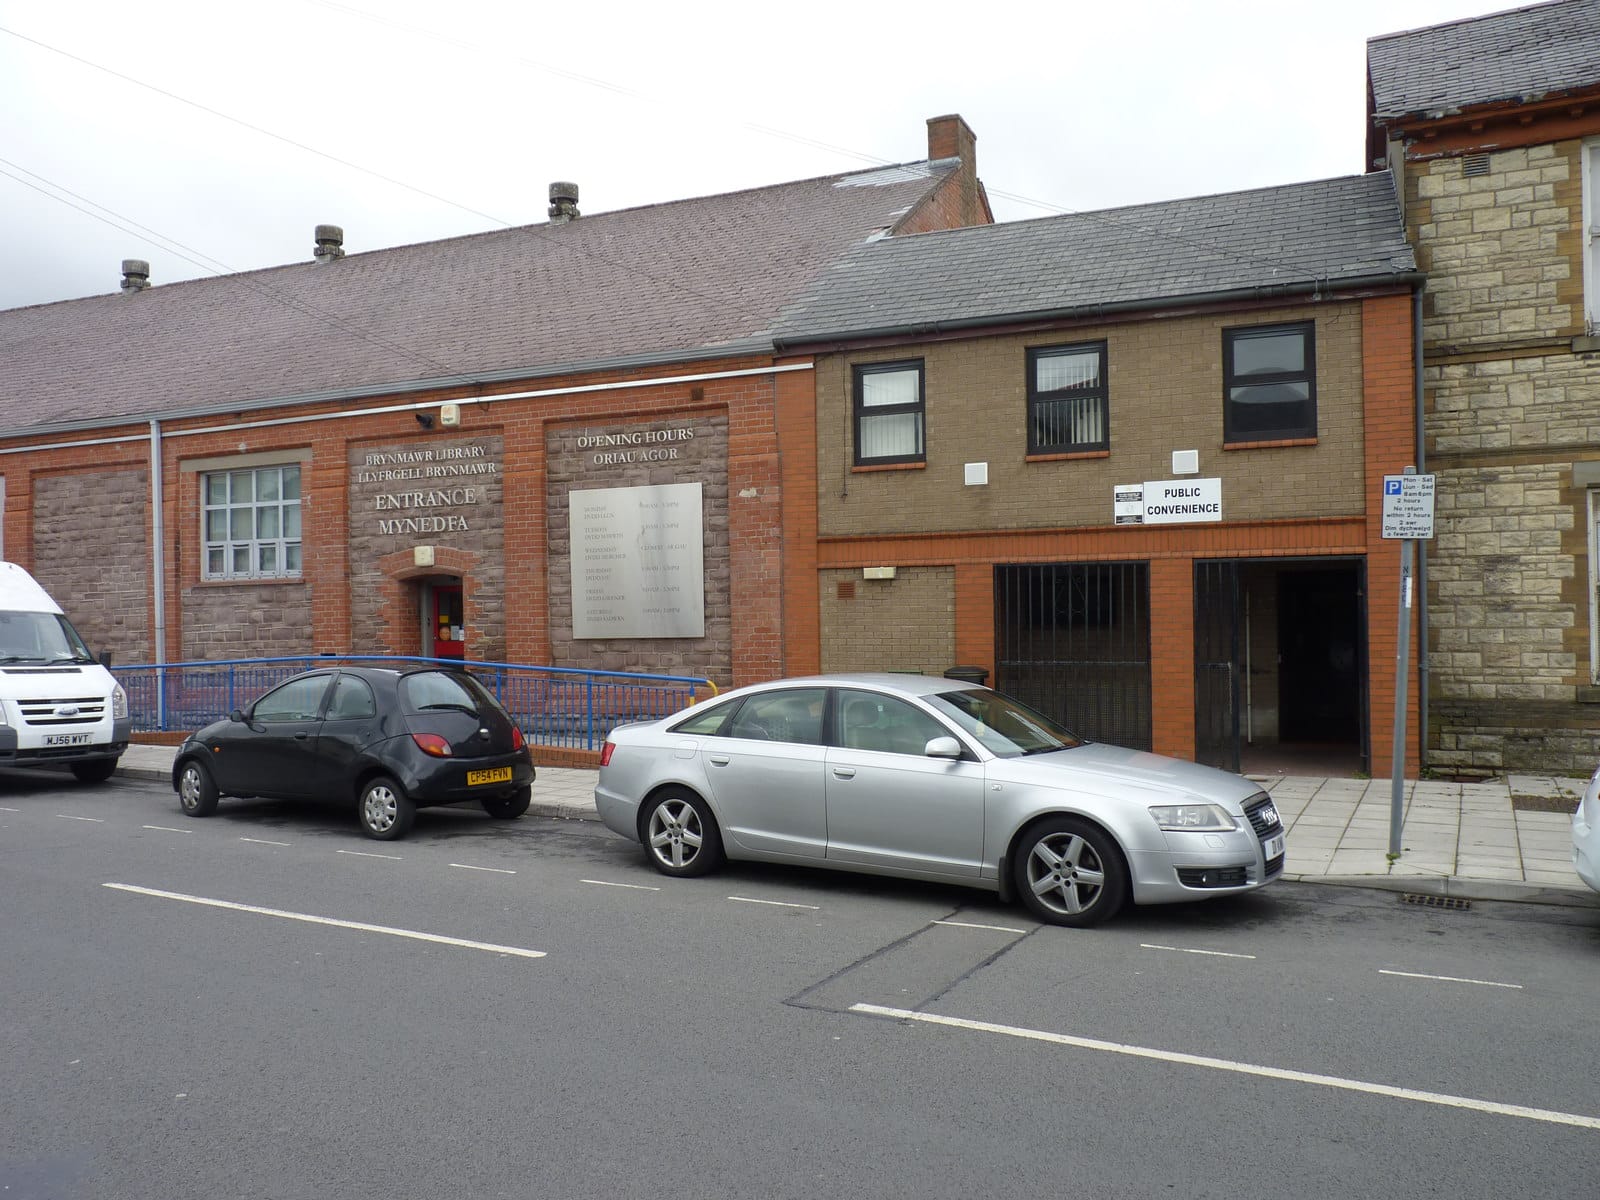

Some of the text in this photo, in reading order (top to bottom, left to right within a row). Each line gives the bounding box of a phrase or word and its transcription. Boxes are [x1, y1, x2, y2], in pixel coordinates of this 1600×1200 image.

[577, 428, 694, 448] OPENING HOURS
[366, 445, 487, 465] BRYNMAWR LIBRARY
[593, 448, 679, 465] ORIAU AGOR
[358, 462, 497, 483] LLYFRGELL BRYNMAWR
[1164, 487, 1201, 498] PUBLIC
[1389, 482, 1399, 494] P
[375, 488, 477, 510] ENTRANCE
[1147, 503, 1219, 515] CONVENIENCE
[378, 515, 469, 535] MYNEDFA
[47, 734, 88, 746] MJ56 WVT
[470, 767, 508, 782] CP54 FVN
